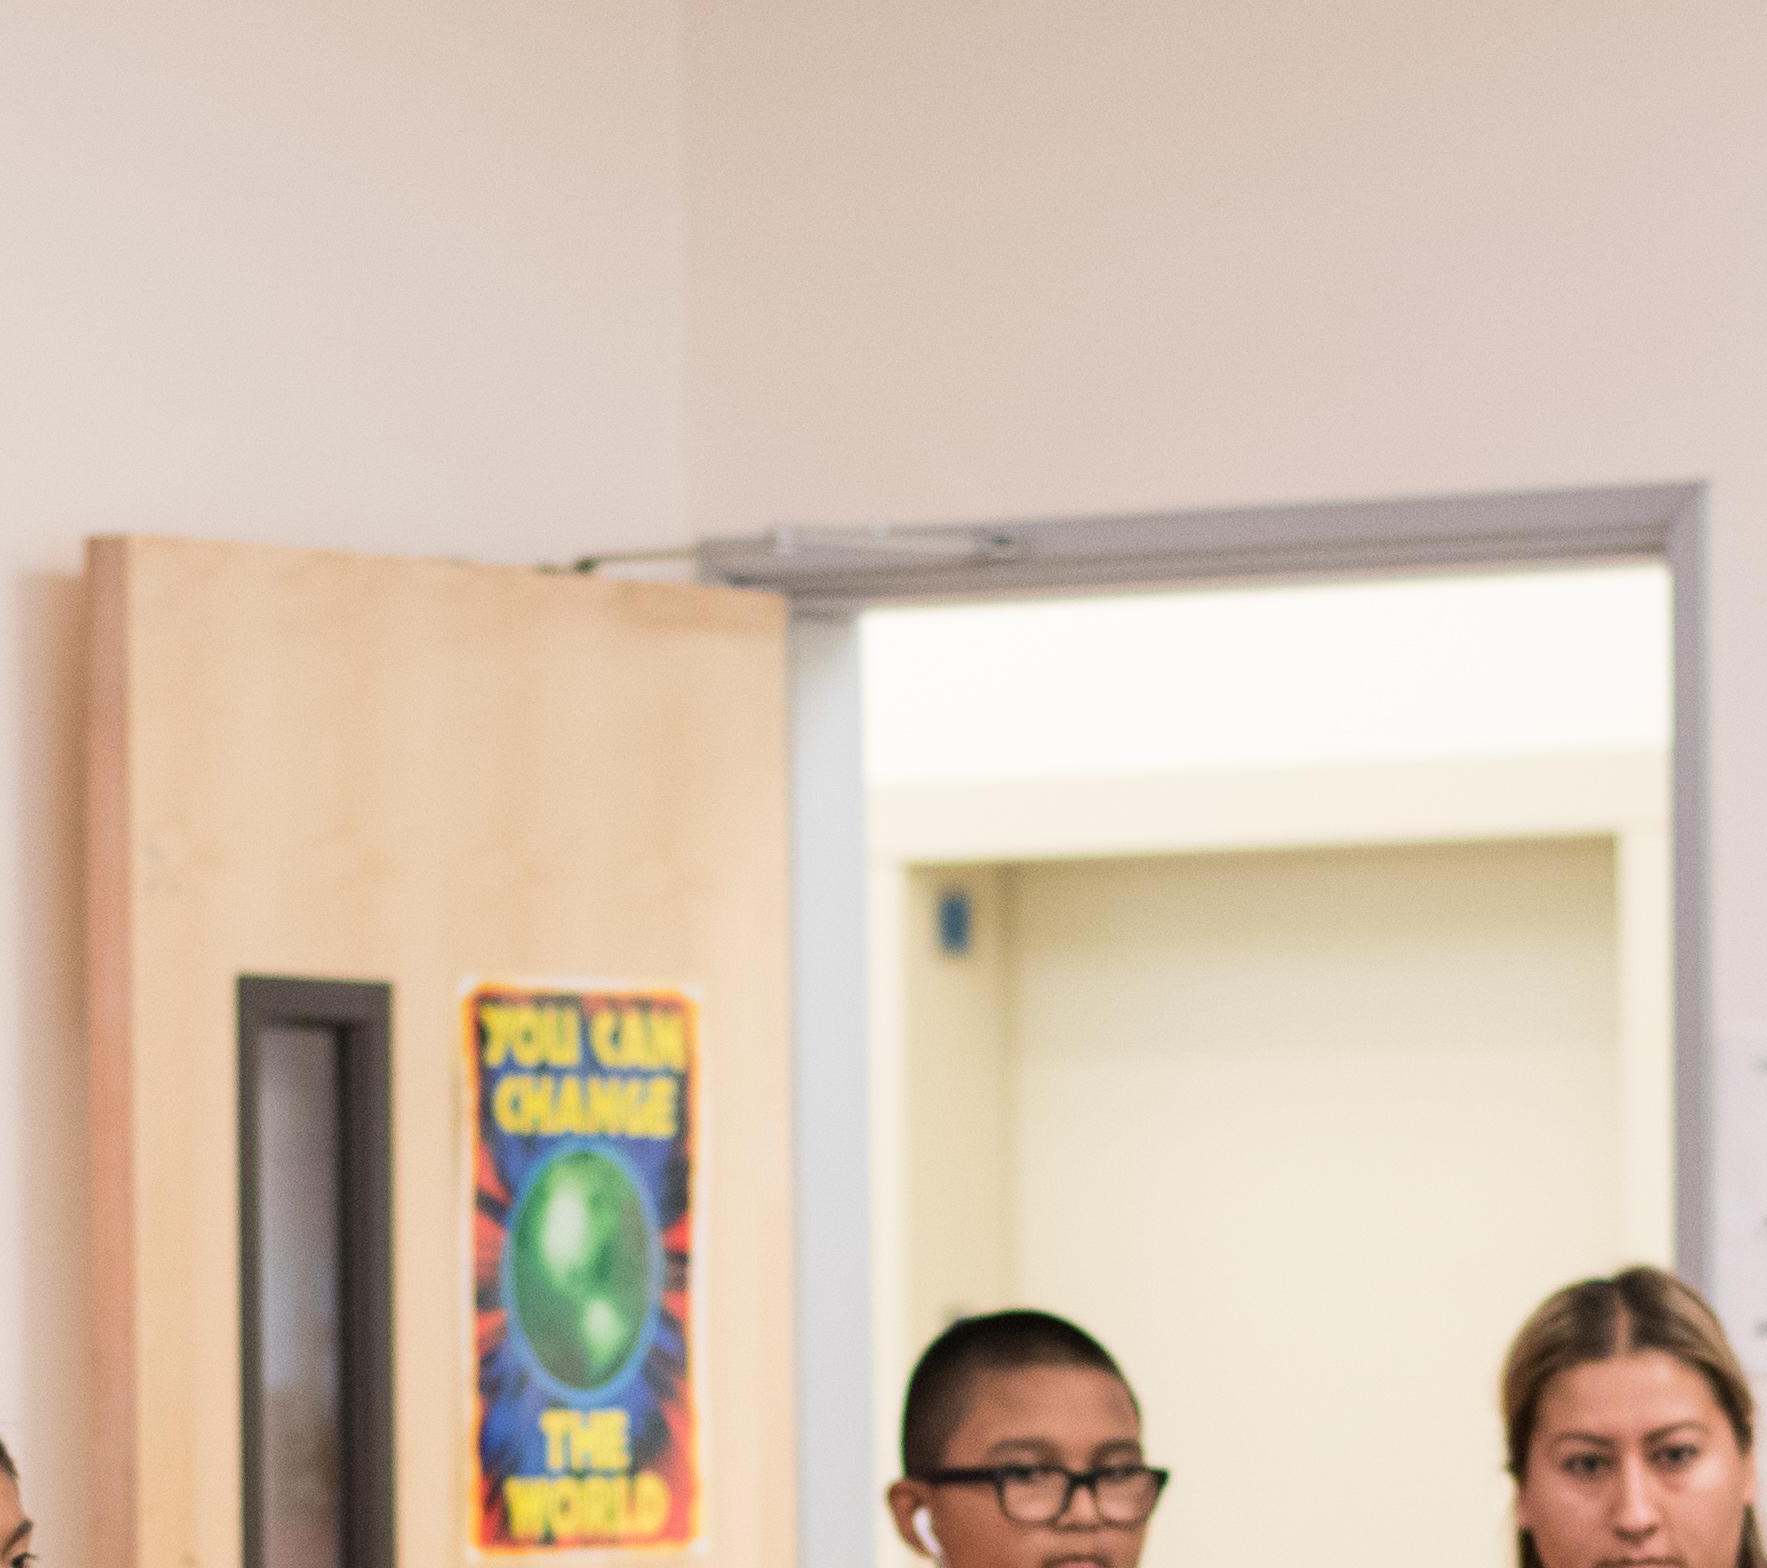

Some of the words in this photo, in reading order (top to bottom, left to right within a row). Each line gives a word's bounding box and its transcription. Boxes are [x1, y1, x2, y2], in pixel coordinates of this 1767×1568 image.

[481, 1003, 580, 1068] YOU
[589, 1008, 686, 1072] CAN
[493, 1073, 678, 1138] CHANGE
[539, 1409, 628, 1472] THE
[504, 1471, 671, 1540] WORLD
